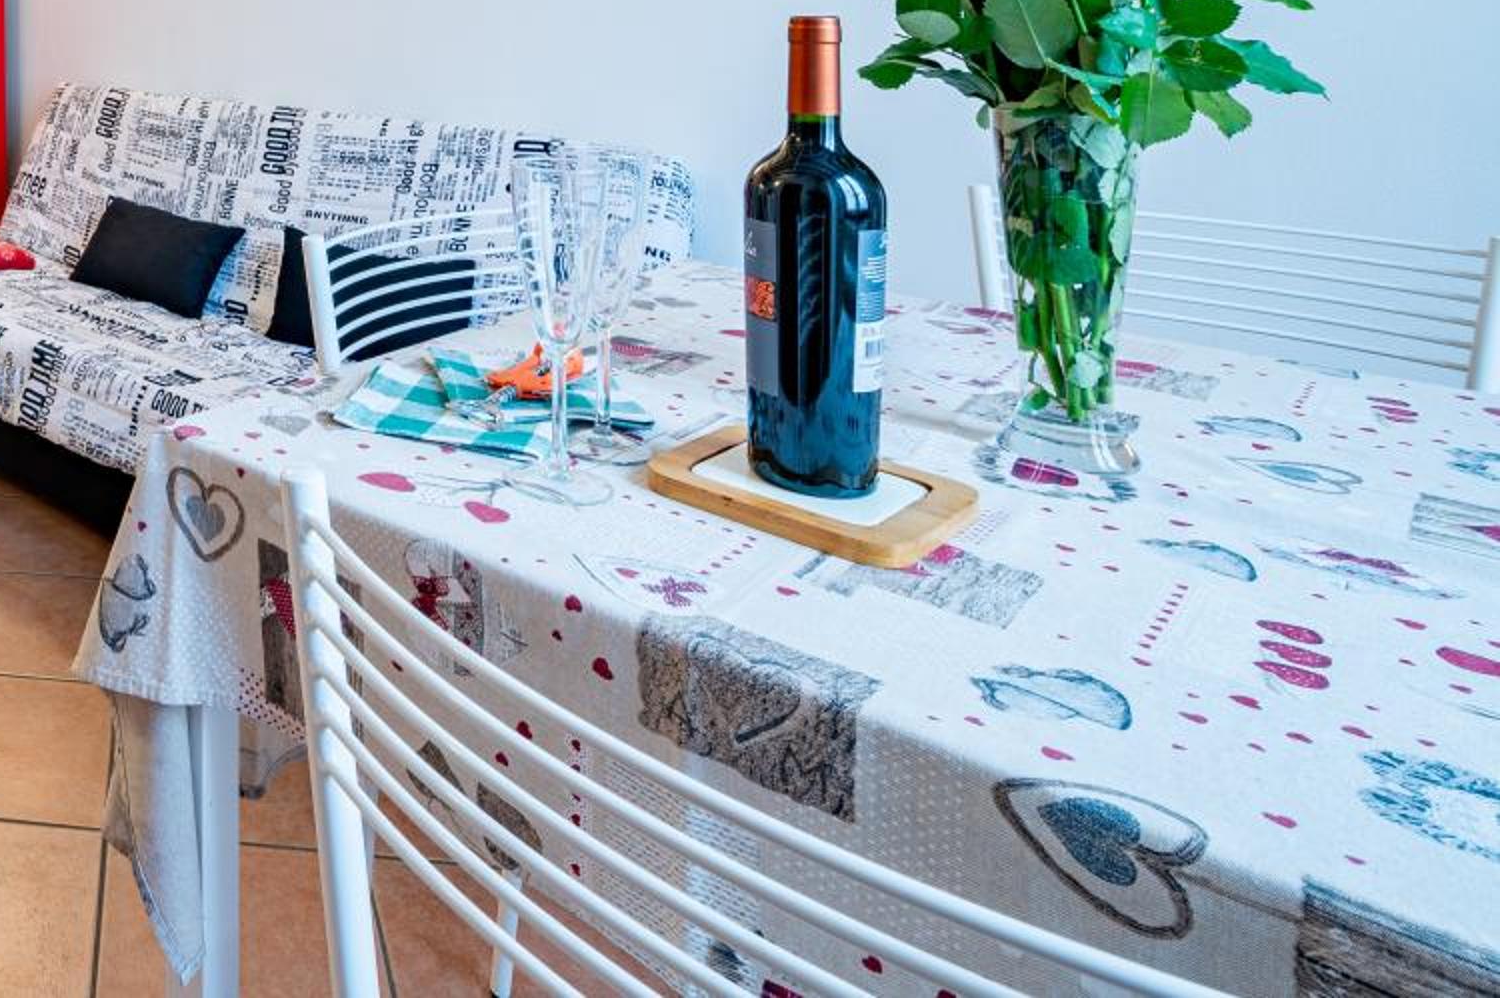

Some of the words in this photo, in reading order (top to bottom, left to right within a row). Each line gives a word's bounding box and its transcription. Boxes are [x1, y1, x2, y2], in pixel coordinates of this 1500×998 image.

[95, 97, 121, 139] GOOD
[260, 127, 291, 176] GOOD
[396, 162, 417, 194] Good
[268, 179, 293, 214] Good
[151, 388, 190, 419] GOOD
